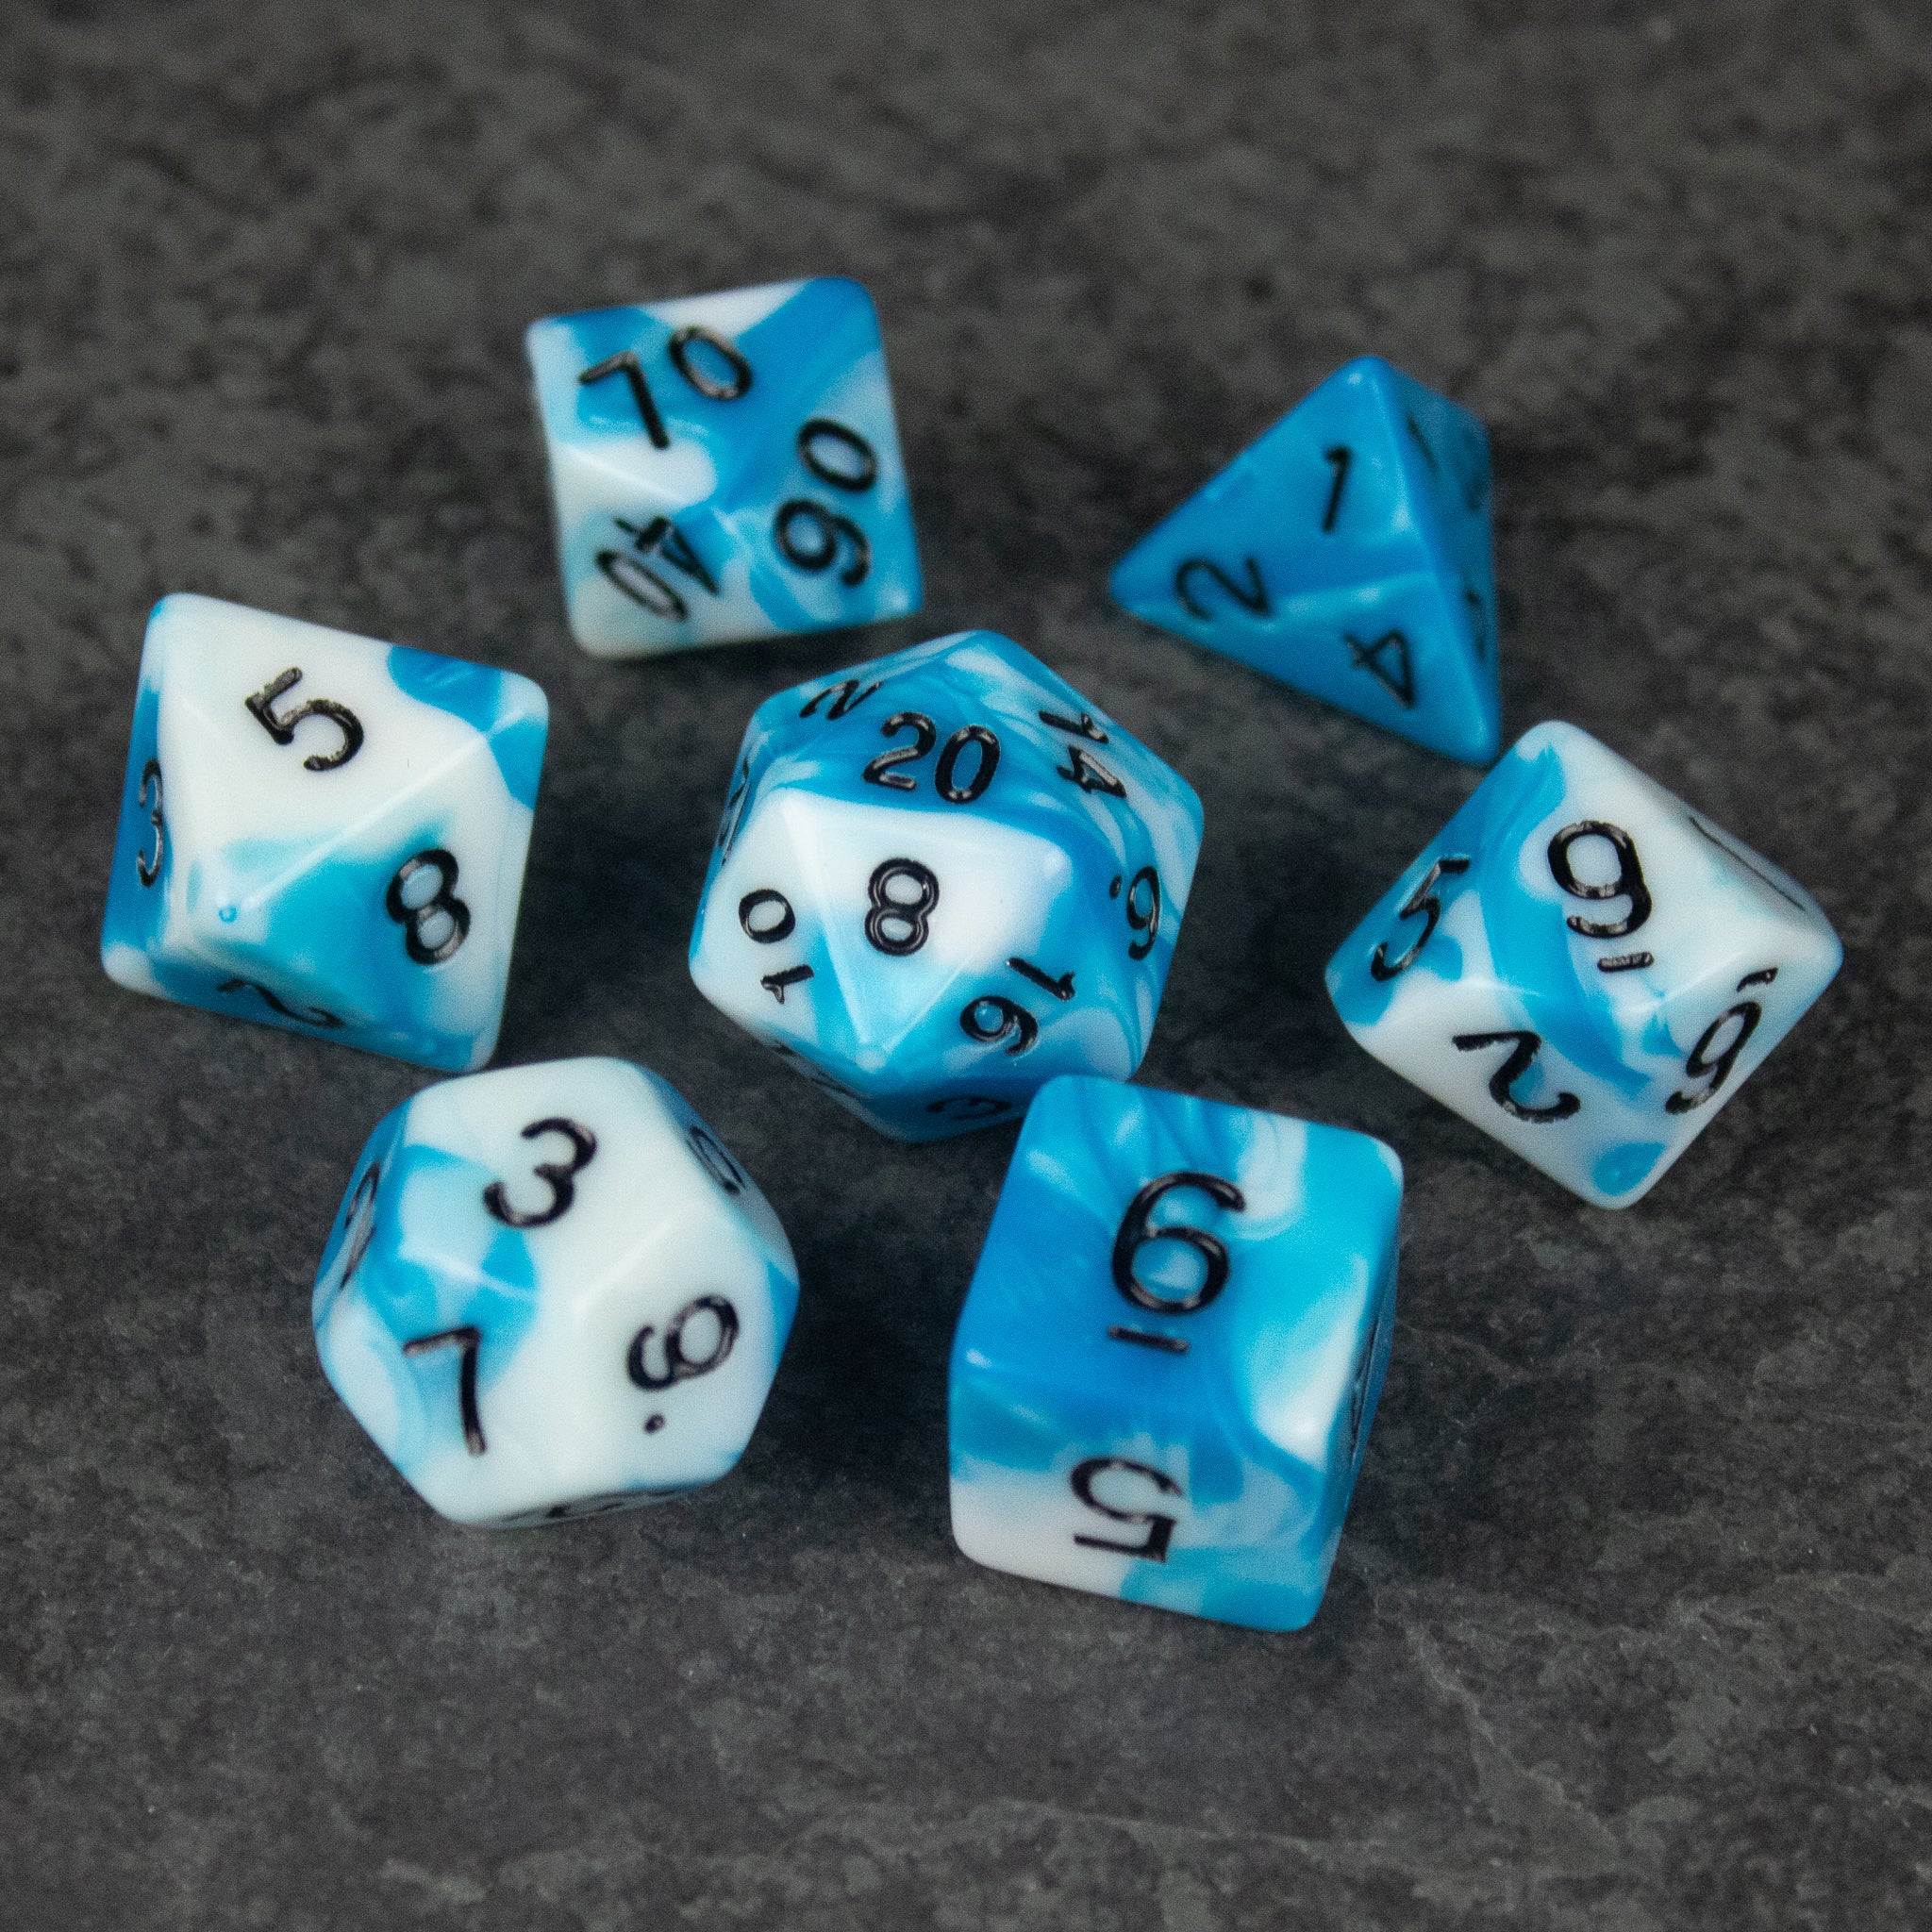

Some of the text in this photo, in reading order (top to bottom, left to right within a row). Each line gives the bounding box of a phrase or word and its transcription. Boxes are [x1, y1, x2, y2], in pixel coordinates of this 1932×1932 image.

[577, 325, 753, 451] 70
[243, 666, 365, 772] 5
[862, 711, 1002, 803] 20
[385, 847, 472, 966] 8
[864, 858, 941, 957] 8
[483, 1117, 598, 1228] 3
[1110, 1171, 1246, 1316] 6
[403, 1325, 488, 1457] 7
[1068, 1455, 1185, 1564] 5
